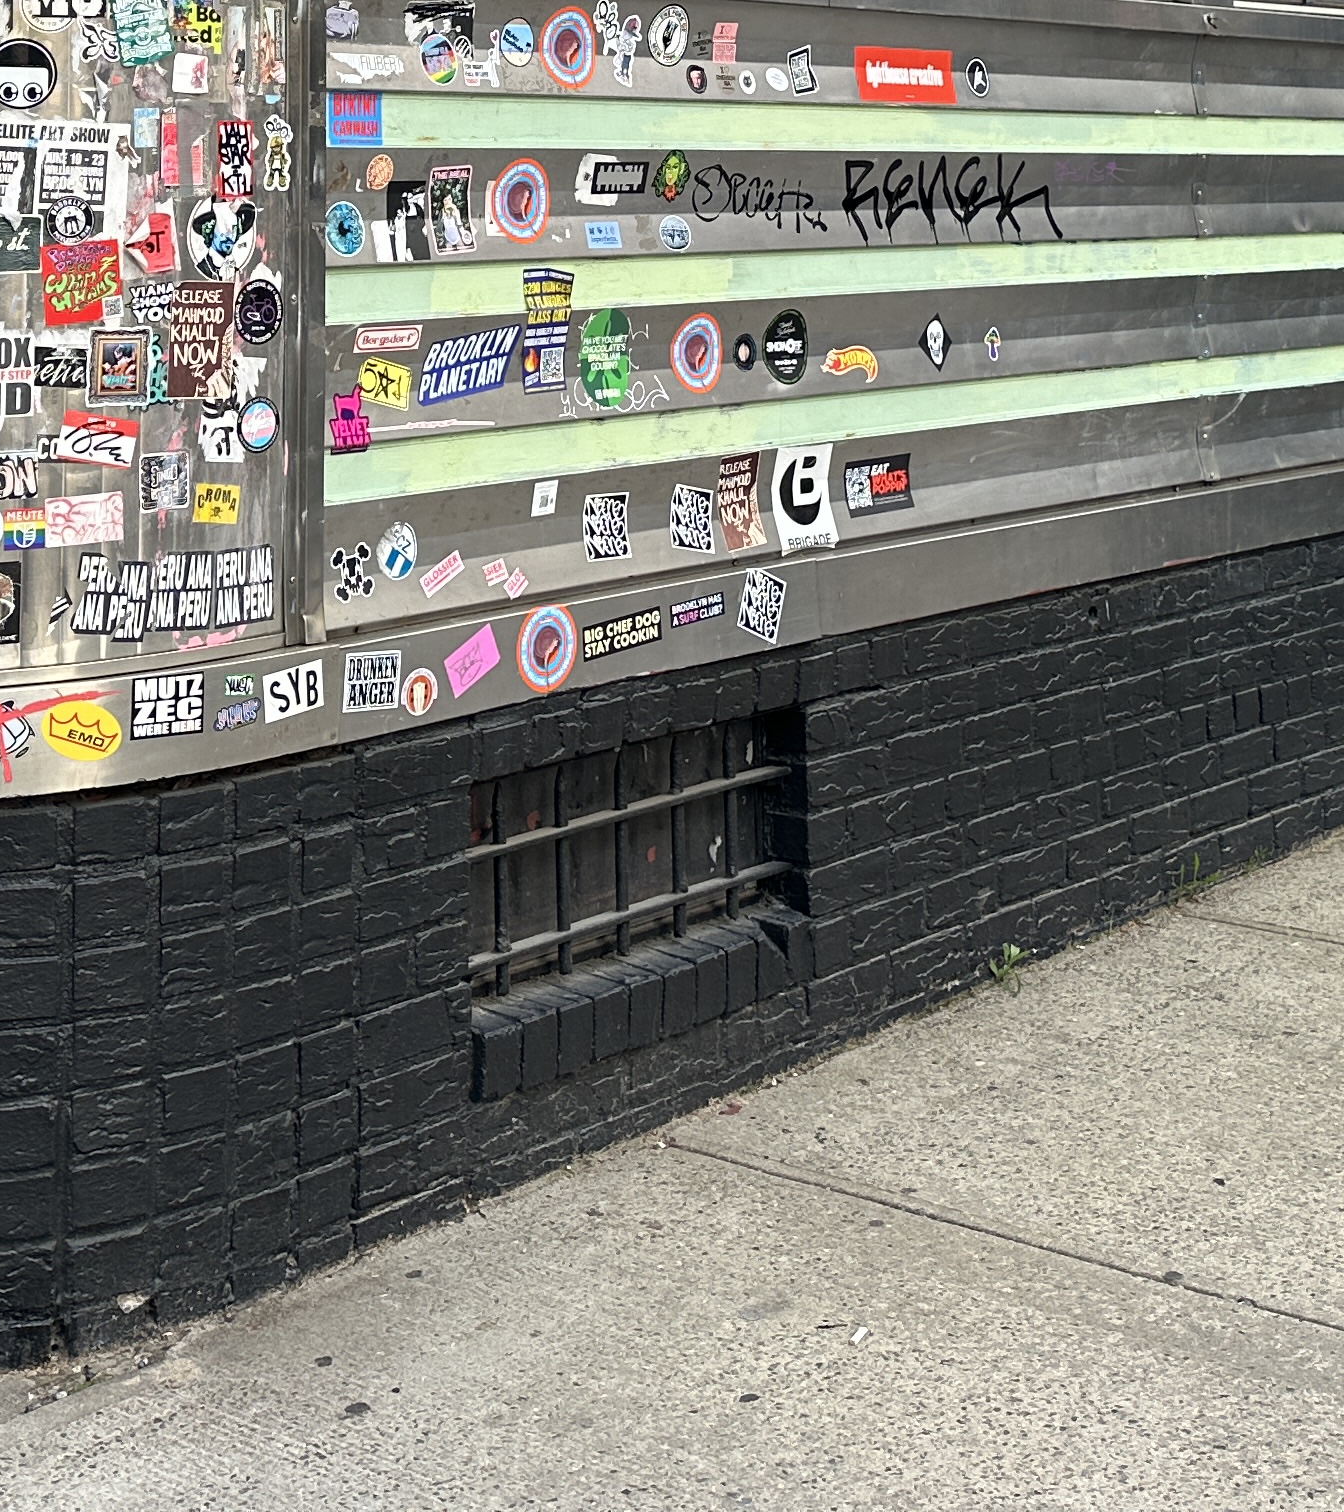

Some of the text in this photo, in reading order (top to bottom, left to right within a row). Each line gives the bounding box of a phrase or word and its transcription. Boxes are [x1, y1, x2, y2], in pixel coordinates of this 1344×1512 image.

[70, 127, 111, 144] SHOW
[172, 289, 224, 304] RELEASE
[171, 306, 225, 324] MAHMOUD
[171, 324, 219, 342] KHALIL
[173, 341, 219, 368] NOW
[423, 325, 520, 373] BROOKLYN
[7, 369, 32, 380] STEP
[419, 356, 508, 402] PLANETARY
[719, 458, 753, 475] RELEASE
[871, 463, 890, 476] EAT
[197, 488, 237, 513] CROMA
[6, 509, 44, 521] MEUTE
[721, 502, 751, 528] NOW
[787, 533, 832, 550] BRIGADE
[187, 554, 212, 589] ANA
[216, 551, 247, 588] PERU
[249, 546, 273, 583] ANA
[422, 554, 460, 588] GLOSSIER
[176, 590, 212, 628] PERU
[215, 588, 242, 626] ANA
[243, 582, 273, 621] PERU
[584, 610, 661, 644] BIG CHEF DOG
[584, 624, 659, 658] STAY COOKIN
[347, 656, 399, 681] DRUNKEN
[134, 674, 204, 702] MUTZ
[270, 668, 319, 713] SYB
[347, 681, 395, 707] ANGER
[133, 696, 203, 725] ZEC
[66, 728, 106, 748] EMO
[133, 719, 202, 738] WERE HERE
